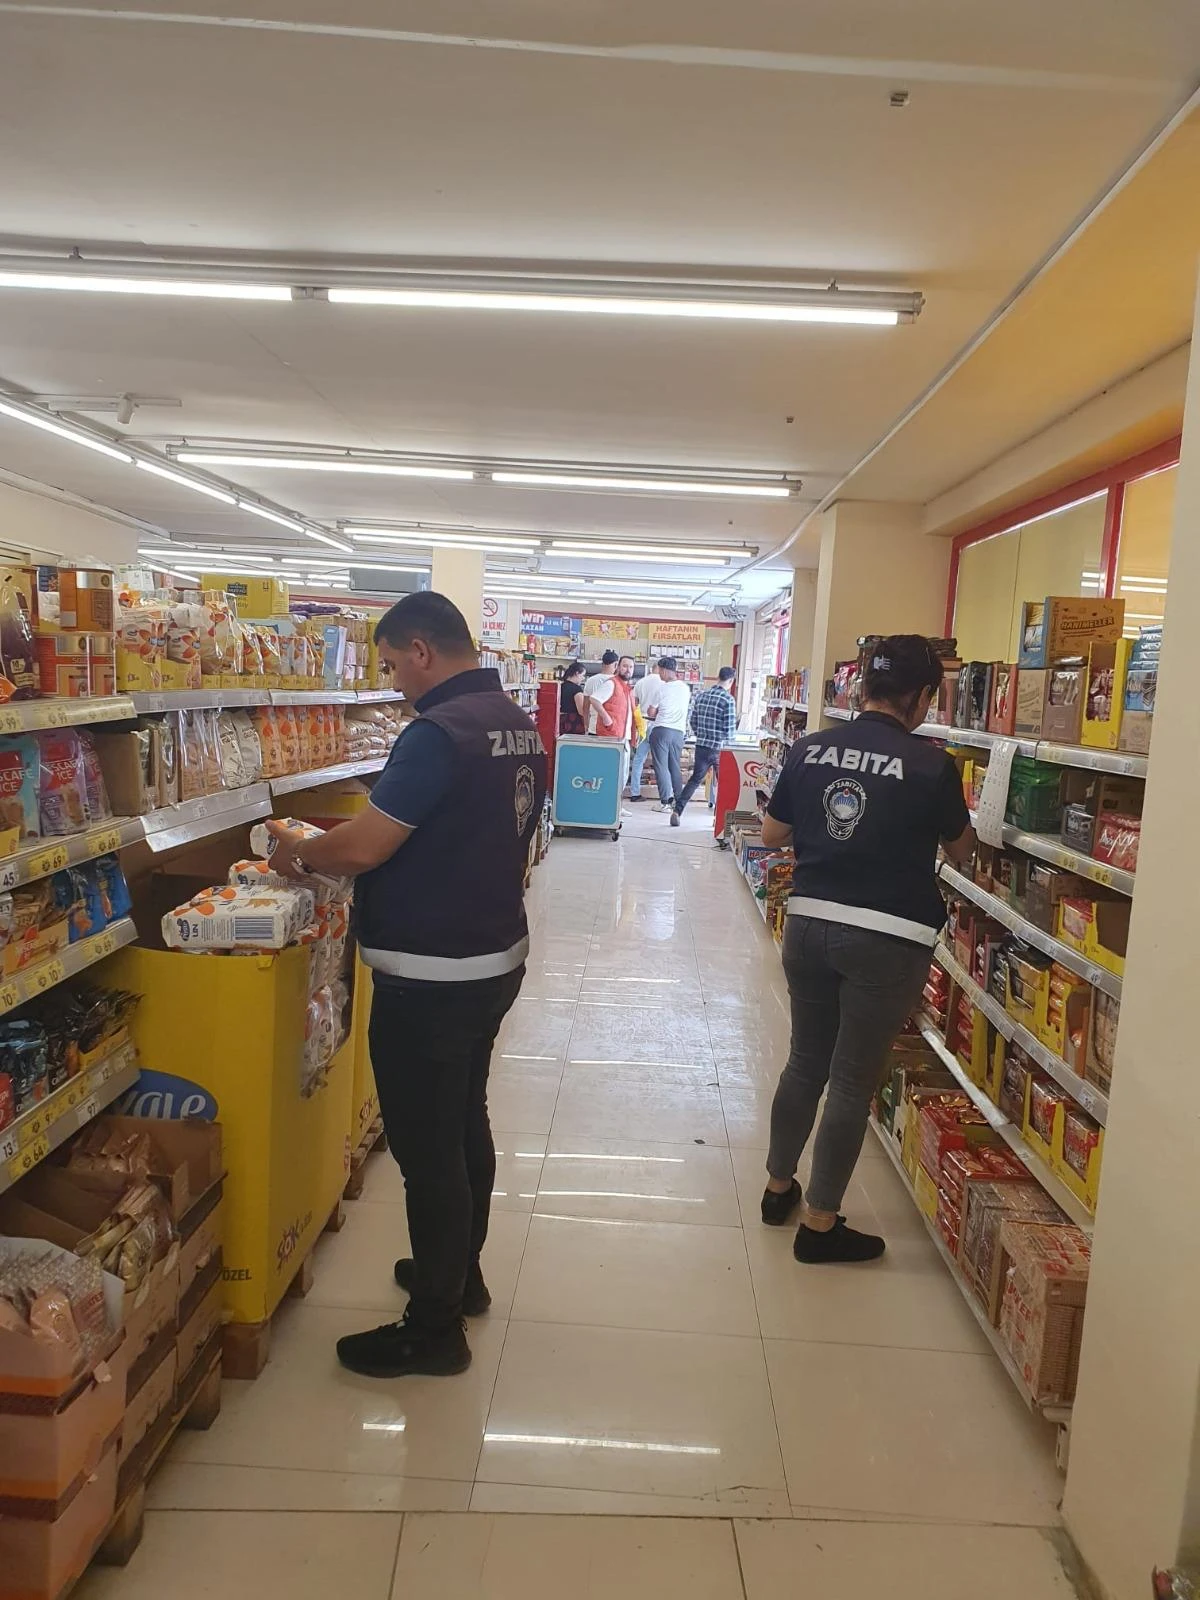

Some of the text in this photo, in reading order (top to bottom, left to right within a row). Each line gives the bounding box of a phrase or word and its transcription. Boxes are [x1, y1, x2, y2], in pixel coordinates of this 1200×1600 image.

[656, 625, 699, 633] HAFTANIN
[652, 633, 701, 641] FIRSATLARI
[487, 730, 546, 757] ZABITA
[804, 744, 904, 780] ZABITA
[571, 776, 604, 790] Golf
[53, 855, 62, 868] 69
[3, 872, 15, 887] 45
[3, 1142, 13, 1158] 13
[222, 1266, 252, 1281] ÖZEL
